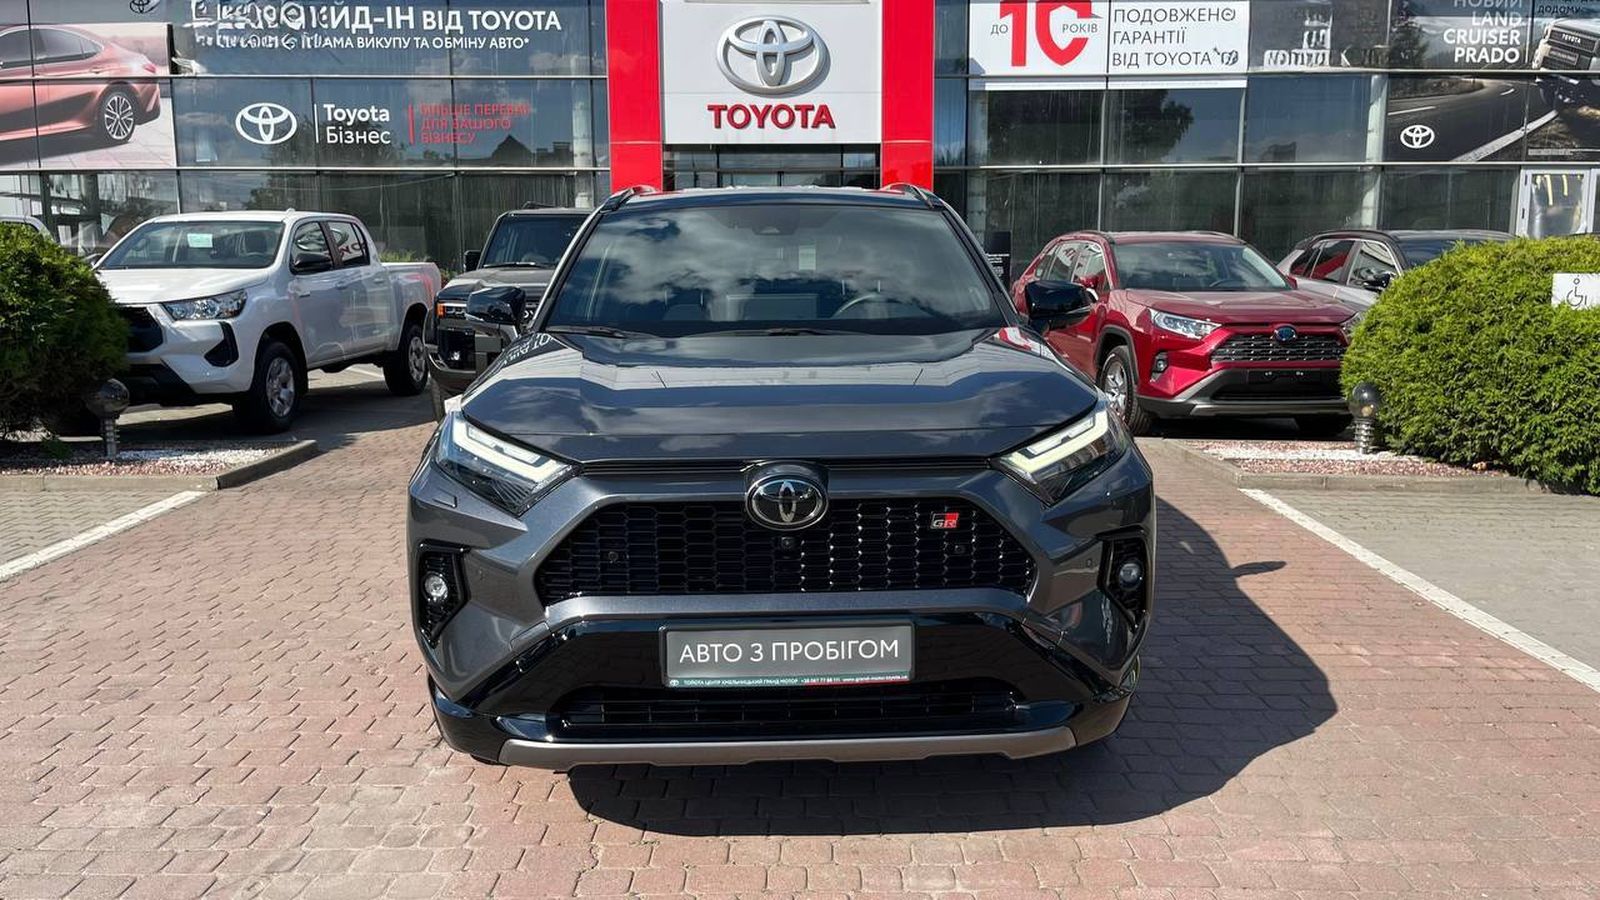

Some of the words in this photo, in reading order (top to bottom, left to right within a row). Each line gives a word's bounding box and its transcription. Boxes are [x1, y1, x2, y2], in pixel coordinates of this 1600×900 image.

[422, 10, 463, 34] ВІД
[468, 10, 562, 31] TOYOTA
[1471, 11, 1523, 26] LAND
[990, 24, 1009, 35] ДО
[1062, 23, 1098, 34] РОКІВ
[1112, 26, 1187, 44] ГАРАНТІЇ
[1443, 29, 1521, 45] CRUISER
[356, 37, 412, 49] ВИКУПУ
[413, 37, 429, 49] ТА
[432, 36, 487, 49] ОБМІНУ
[1112, 52, 1140, 69] ВІД
[1145, 52, 1212, 66] TOYOTA
[1453, 47, 1520, 64] PRADO
[323, 103, 390, 126] Toyota
[707, 104, 836, 129] TOYOTA
[326, 126, 391, 144] Бізнес
[679, 643, 742, 664] АВТО
[771, 639, 899, 662] ПРОБІГОМ
